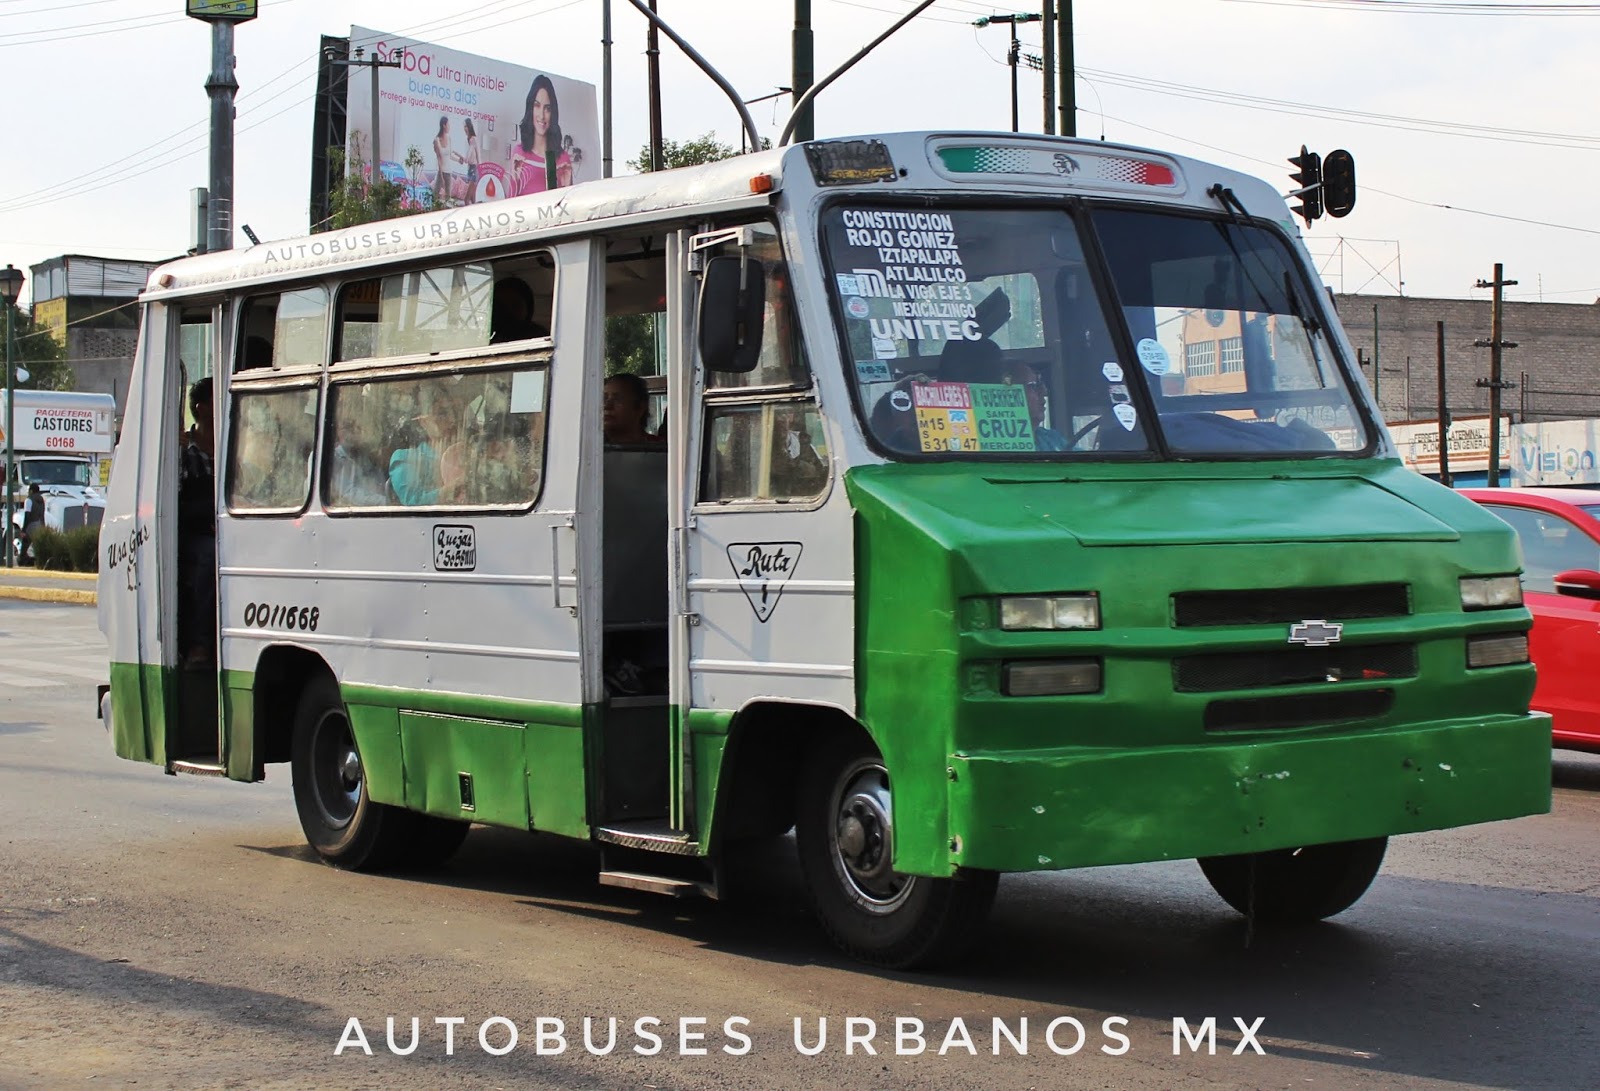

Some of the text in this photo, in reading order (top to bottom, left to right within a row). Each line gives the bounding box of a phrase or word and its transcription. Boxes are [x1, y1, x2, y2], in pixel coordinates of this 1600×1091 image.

[436, 66, 461, 82] ultra
[464, 70, 505, 92] invisible
[408, 77, 451, 100] buenos
[380, 90, 407, 104] Protege
[408, 96, 426, 107] igual
[426, 101, 439, 113] que
[440, 104, 453, 113] una
[453, 106, 472, 118] toalla
[843, 210, 953, 231] CONSTITUCION
[846, 229, 958, 250] ROJO GOMEZ
[878, 248, 962, 265] IZTAPALAPA
[885, 266, 966, 282] ATLALILCO
[888, 284, 972, 300] LA VIGA EJE 3
[892, 301, 976, 319] MEXICALZINGO
[870, 319, 982, 341] UNITEC
[35, 409, 92, 418] PAQUETERIA
[986, 410, 1016, 418] SANTA
[33, 416, 93, 432] CASTORES
[929, 418, 945, 430] 15
[978, 419, 1030, 438] CRUZ
[46, 437, 75, 448] 60168
[933, 438, 948, 451] 31
[963, 438, 977, 450] 47
[980, 441, 1033, 450] MERCADO
[1414, 432, 1447, 443] FERRETE
[1521, 444, 1594, 476] Vision
[437, 529, 472, 549] Quejas
[740, 546, 791, 577] Ruta
[244, 602, 319, 631] 0011668
